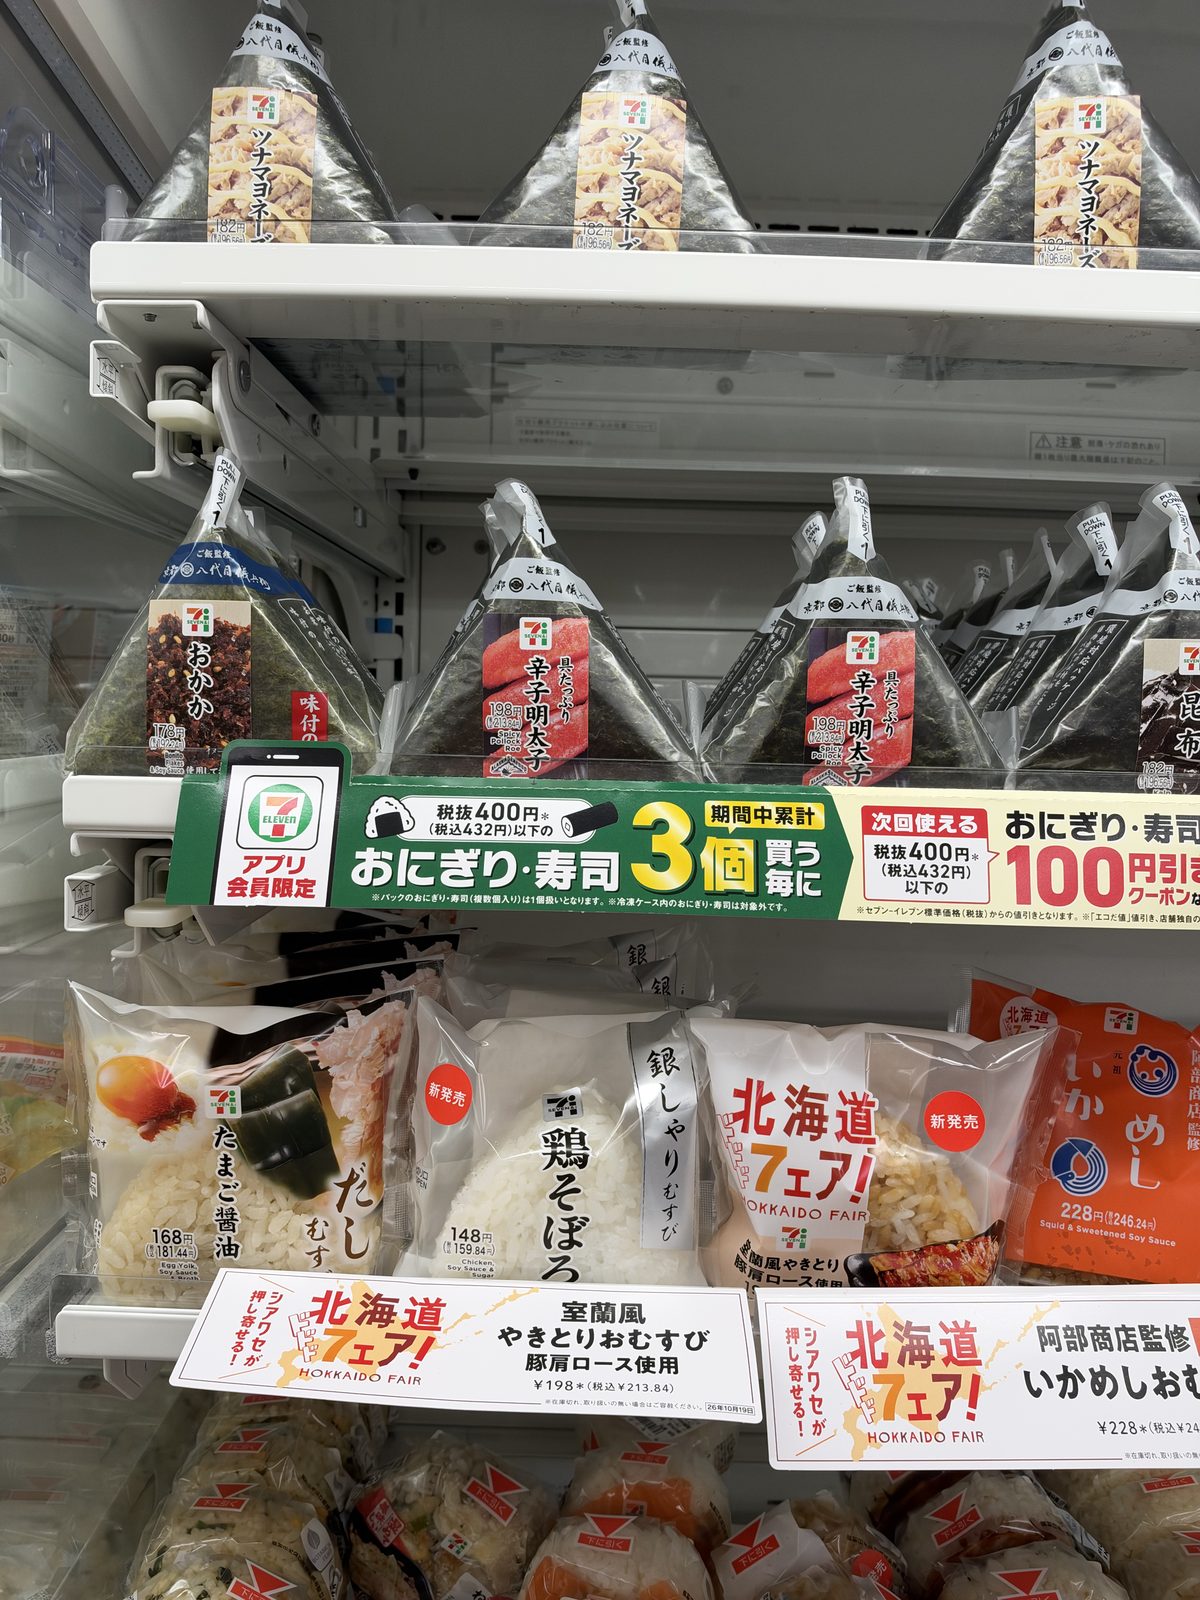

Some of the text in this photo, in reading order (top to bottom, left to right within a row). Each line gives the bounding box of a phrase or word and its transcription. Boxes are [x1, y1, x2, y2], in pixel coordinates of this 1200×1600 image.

[1078, 140, 1101, 268] ツナマヨネーズ
[581, 222, 613, 237] 182円
[220, 459, 236, 475] PULL
[212, 510, 221, 526] 1
[1082, 516, 1102, 529] PULL
[538, 527, 546, 544] 1
[186, 641, 214, 720] おかか
[556, 656, 574, 724] 具たっぷり
[490, 702, 522, 717] 198円
[524, 656, 550, 772] 辛子明太子
[882, 672, 900, 738] 具たっぷり
[152, 722, 186, 738] 178円
[498, 730, 520, 740] Spicy
[812, 716, 845, 732] 198円
[845, 670, 876, 786] 辛子明太子
[811, 752, 842, 760] Pollock
[820, 744, 842, 754] Spicy
[262, 815, 297, 824] ELEVEN
[710, 804, 816, 826] 期間中累計
[872, 812, 978, 834] 次回使える
[429, 822, 554, 838] (税込432円)以下の
[1006, 810, 1200, 844] おにぎり・寿司
[766, 839, 821, 868] 買う
[243, 855, 306, 875] アプリ
[351, 847, 621, 893] おにぎり・寿司
[881, 863, 972, 880] (税込432円)
[226, 877, 316, 898] 会員限定
[766, 870, 822, 897] 毎に
[904, 880, 948, 895] 以下の
[627, 944, 648, 966] 銀
[652, 976, 671, 996] 銀
[1007, 1006, 1050, 1024] 北海道
[428, 1082, 468, 1108] 新発売
[1064, 1054, 1104, 1122] いか
[732, 1078, 879, 1145] 北海道
[930, 1114, 980, 1130] 新発売
[1124, 1112, 1166, 1191] めし
[214, 1126, 241, 1260] たまご醤油
[334, 1161, 374, 1261] だし
[541, 1128, 590, 1283] 鶏そぼろ
[830, 1210, 868, 1222] FAIR
[152, 1229, 194, 1246] 168円
[450, 1228, 492, 1244] 148円
[1040, 1219, 1066, 1231] Squid
[1076, 1225, 1126, 1239] Sweetened
[1128, 1232, 1145, 1244] Soy
[1148, 1236, 1176, 1248] Sauce
[304, 1218, 332, 1272] むす
[740, 1238, 840, 1274] 室蘭風やきとり
[160, 1262, 176, 1271] Egg
[160, 1268, 173, 1277] Soy
[447, 1264, 462, 1273] Soy
[461, 1258, 495, 1268] Chicken,
[310, 1290, 447, 1332] 北海道
[560, 1300, 646, 1325] 室蘭風
[230, 1290, 266, 1366] 押し寄せる!
[244, 1292, 284, 1367] シアワセが
[498, 1326, 710, 1352] やきとりおむすび
[1036, 1324, 1190, 1352] 阿部商店監修
[846, 1320, 982, 1369] 北海道
[525, 1354, 680, 1375] 豚肩ロース使用
[299, 1367, 422, 1386] HOKKAIDO FAIR
[785, 1327, 805, 1437] 押し寄せる!
[804, 1327, 827, 1436] シアワセが
[706, 1403, 754, 1414] 26年10月19日
[868, 1431, 984, 1444] HOKKAIDO FAIR
[739, 1544, 773, 1566] 下に引く
